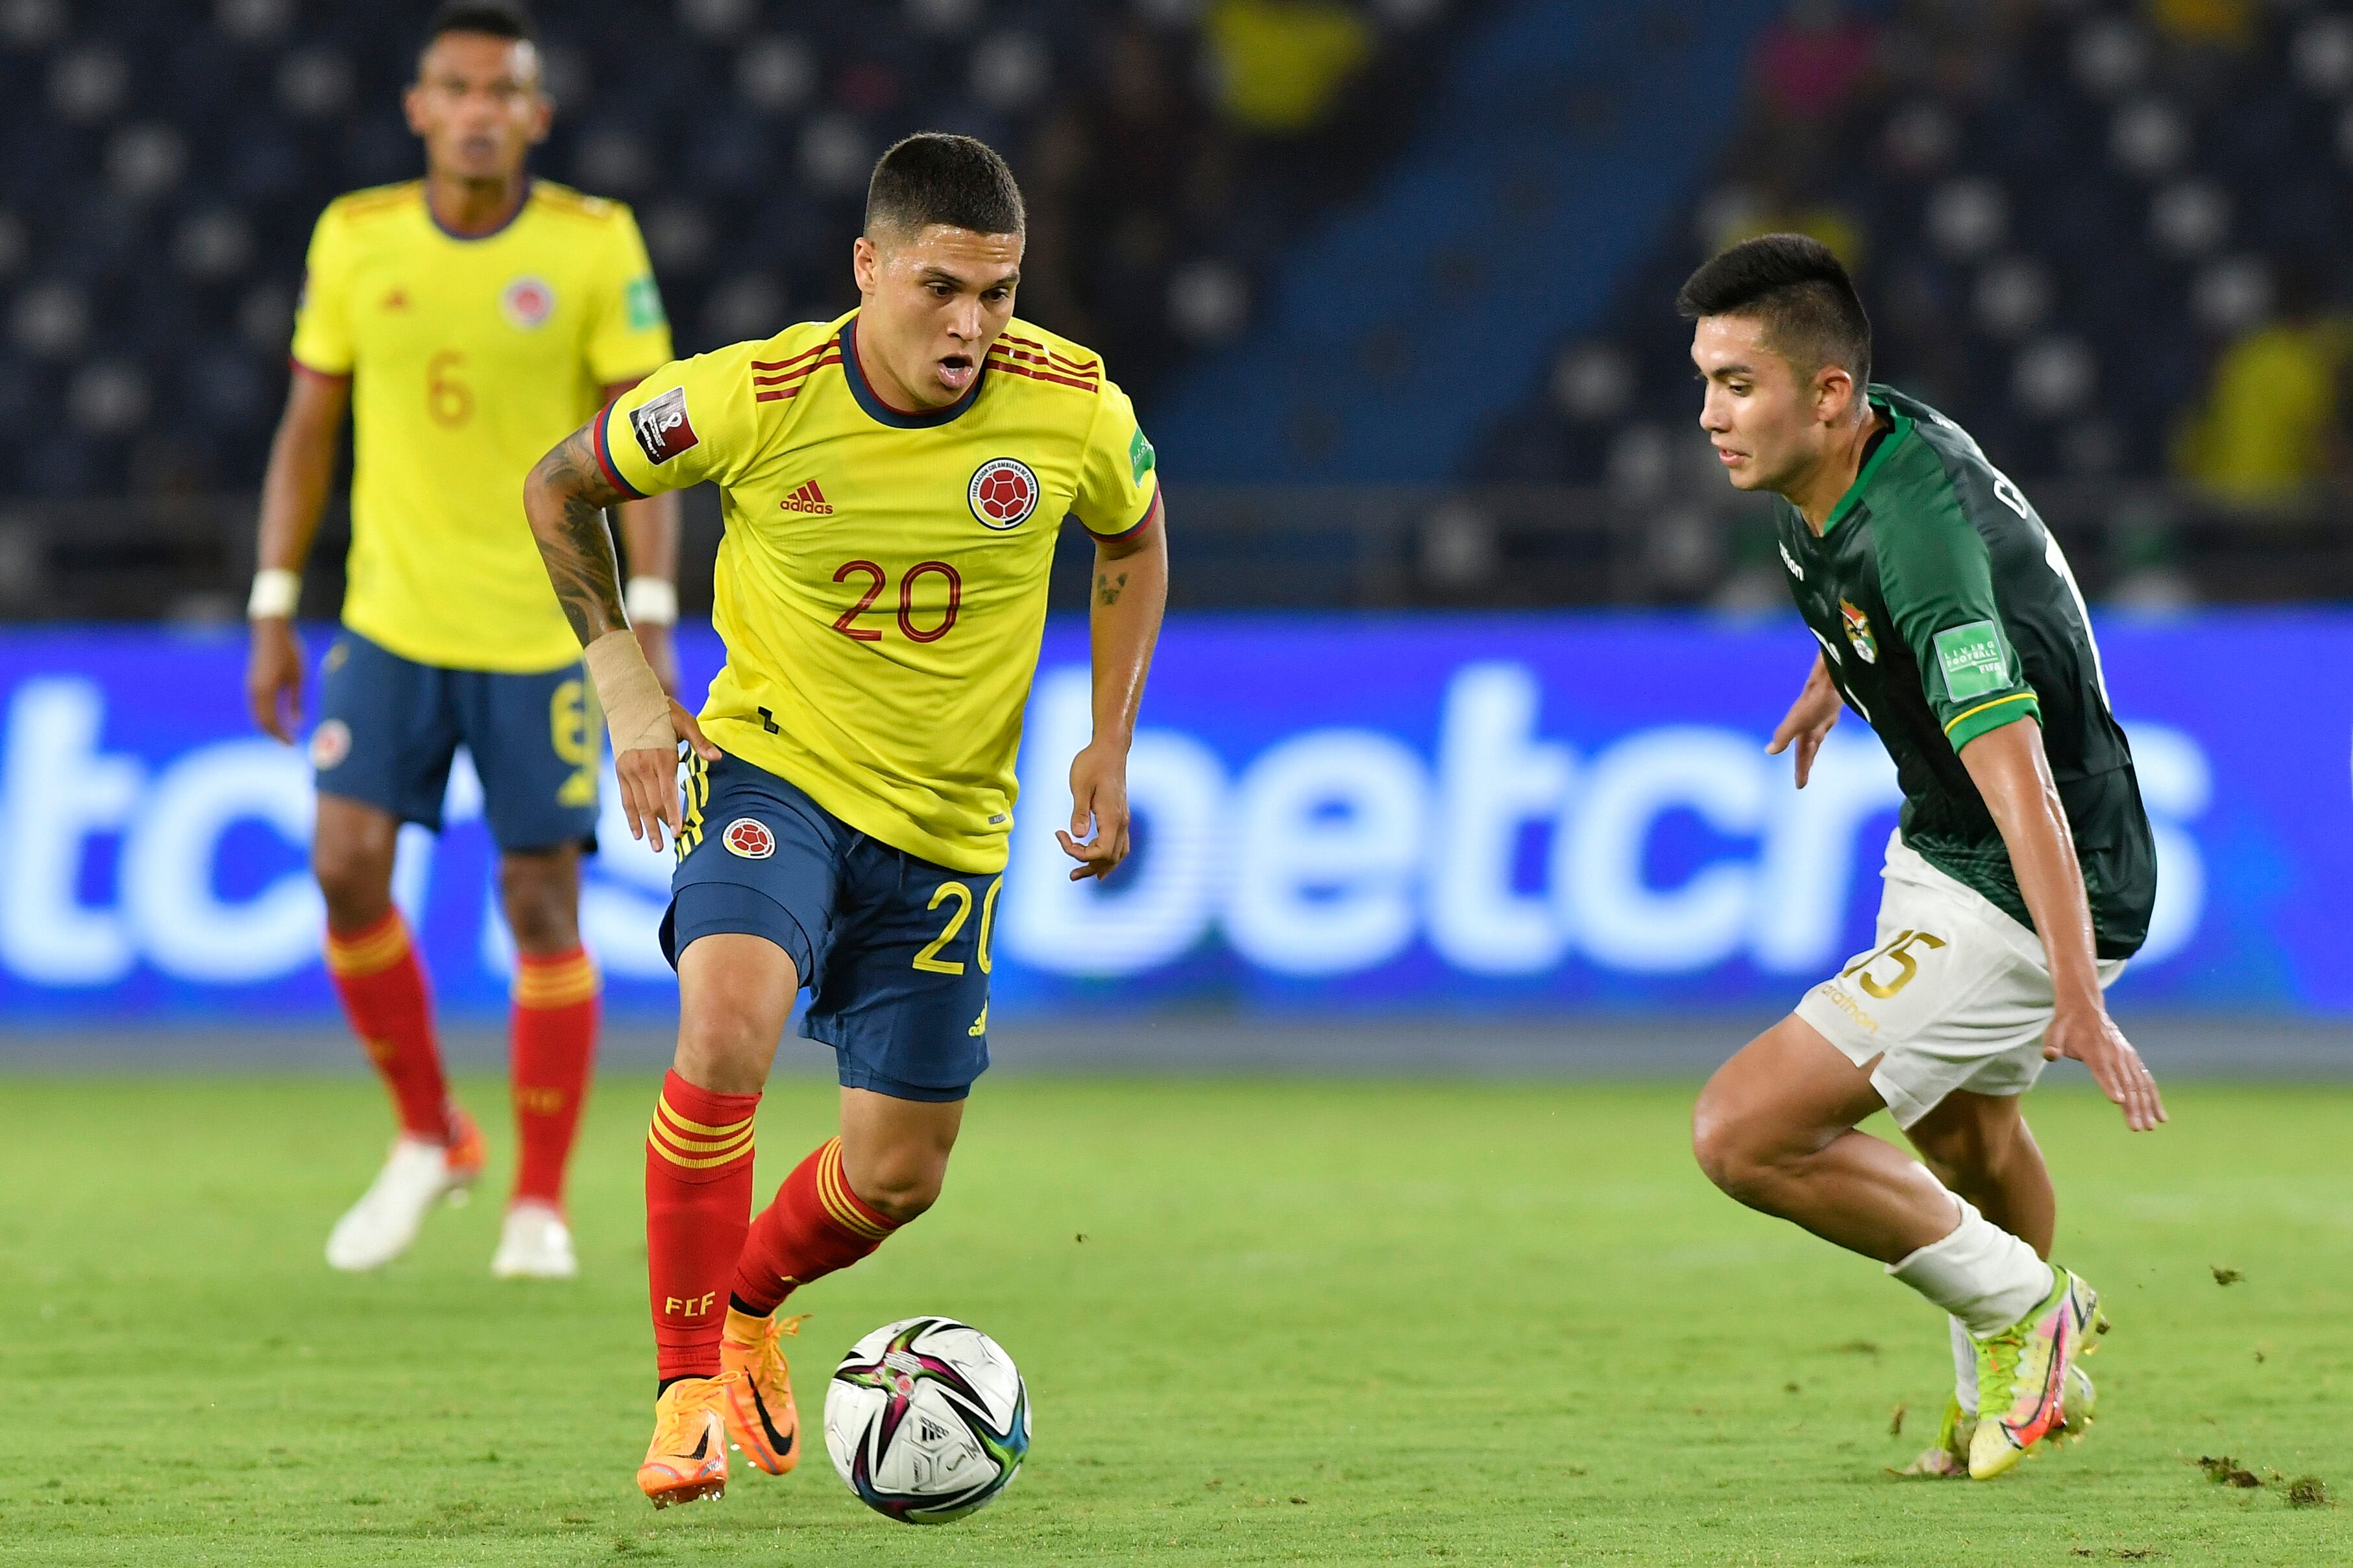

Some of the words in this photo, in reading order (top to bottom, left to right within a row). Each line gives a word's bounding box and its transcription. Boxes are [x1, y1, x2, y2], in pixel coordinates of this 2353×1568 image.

[426, 349, 474, 430] 6
[779, 499, 833, 514] adidas
[832, 559, 962, 644] 20
[1944, 641, 1995, 659] LIVING
[1946, 649, 1997, 668] FOOTBALL
[1979, 662, 2002, 674] FIFA
[549, 679, 601, 766] 6
[1840, 928, 1947, 1000] 15
[664, 1290, 716, 1317] FCF
